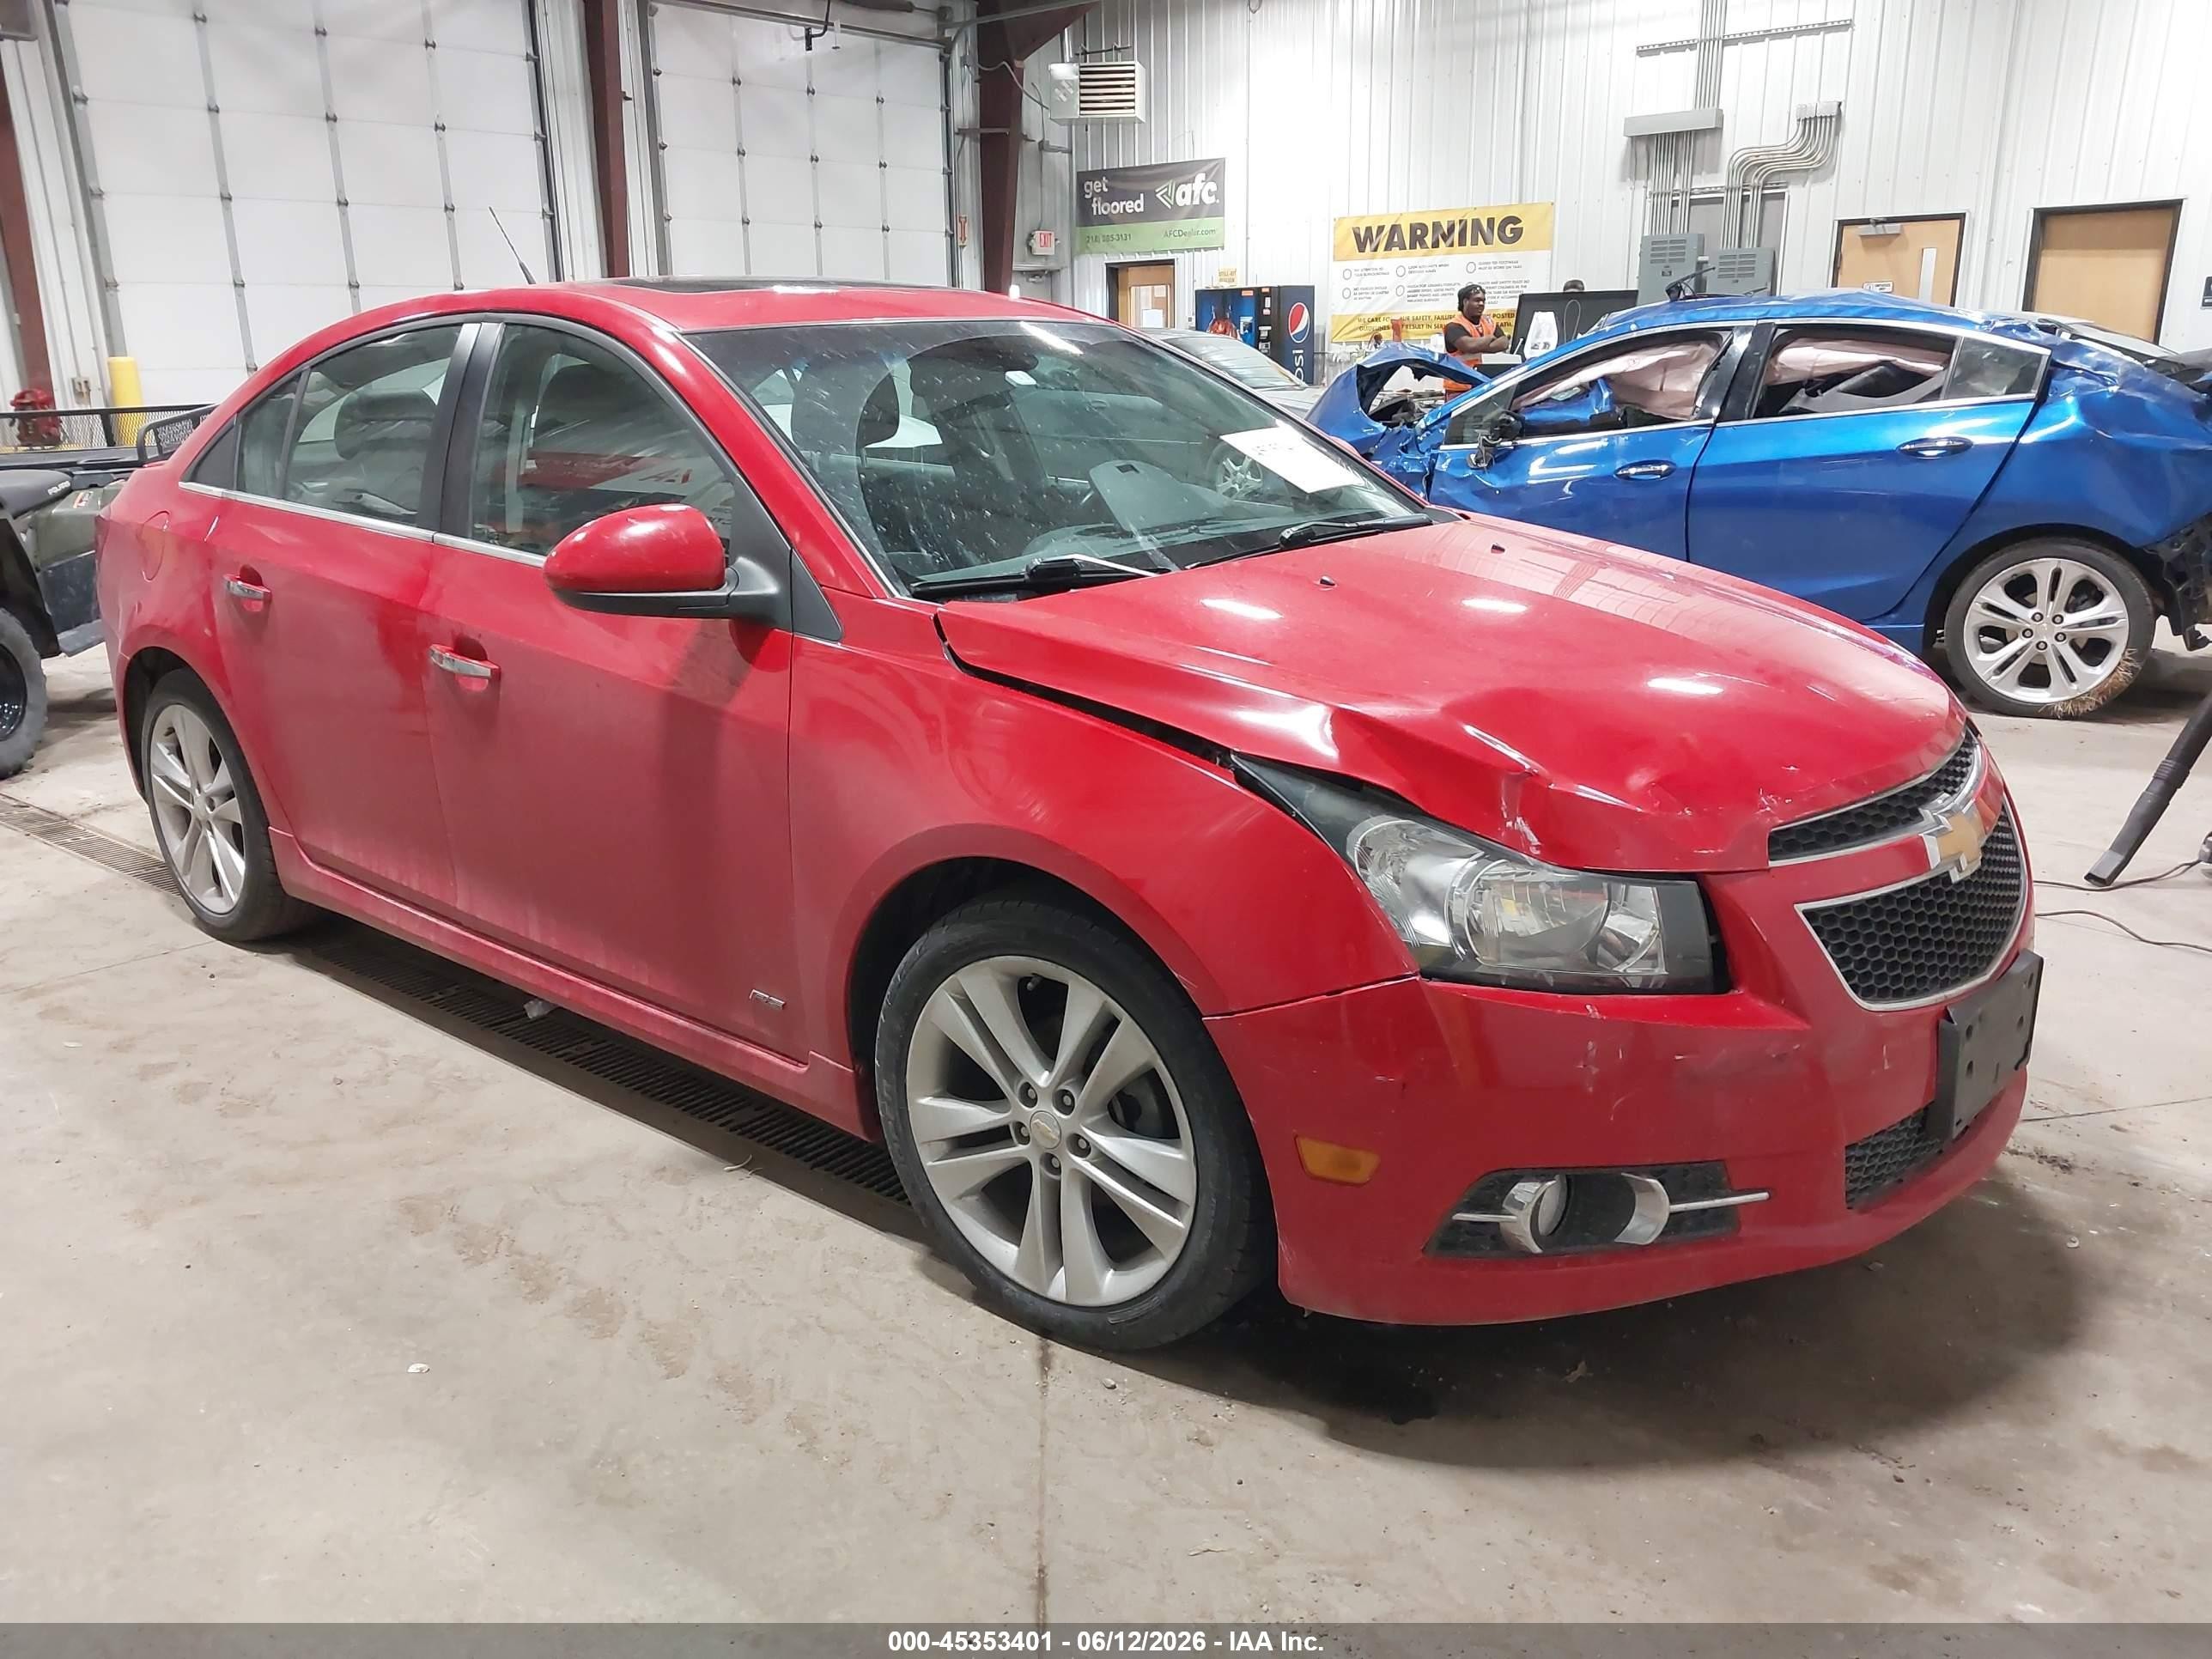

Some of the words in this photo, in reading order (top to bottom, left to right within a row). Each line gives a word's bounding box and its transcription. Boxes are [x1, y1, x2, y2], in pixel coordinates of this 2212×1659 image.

[1084, 177, 1109, 198] get
[1091, 193, 1145, 216] floored
[1352, 215, 1524, 253] WARNING
